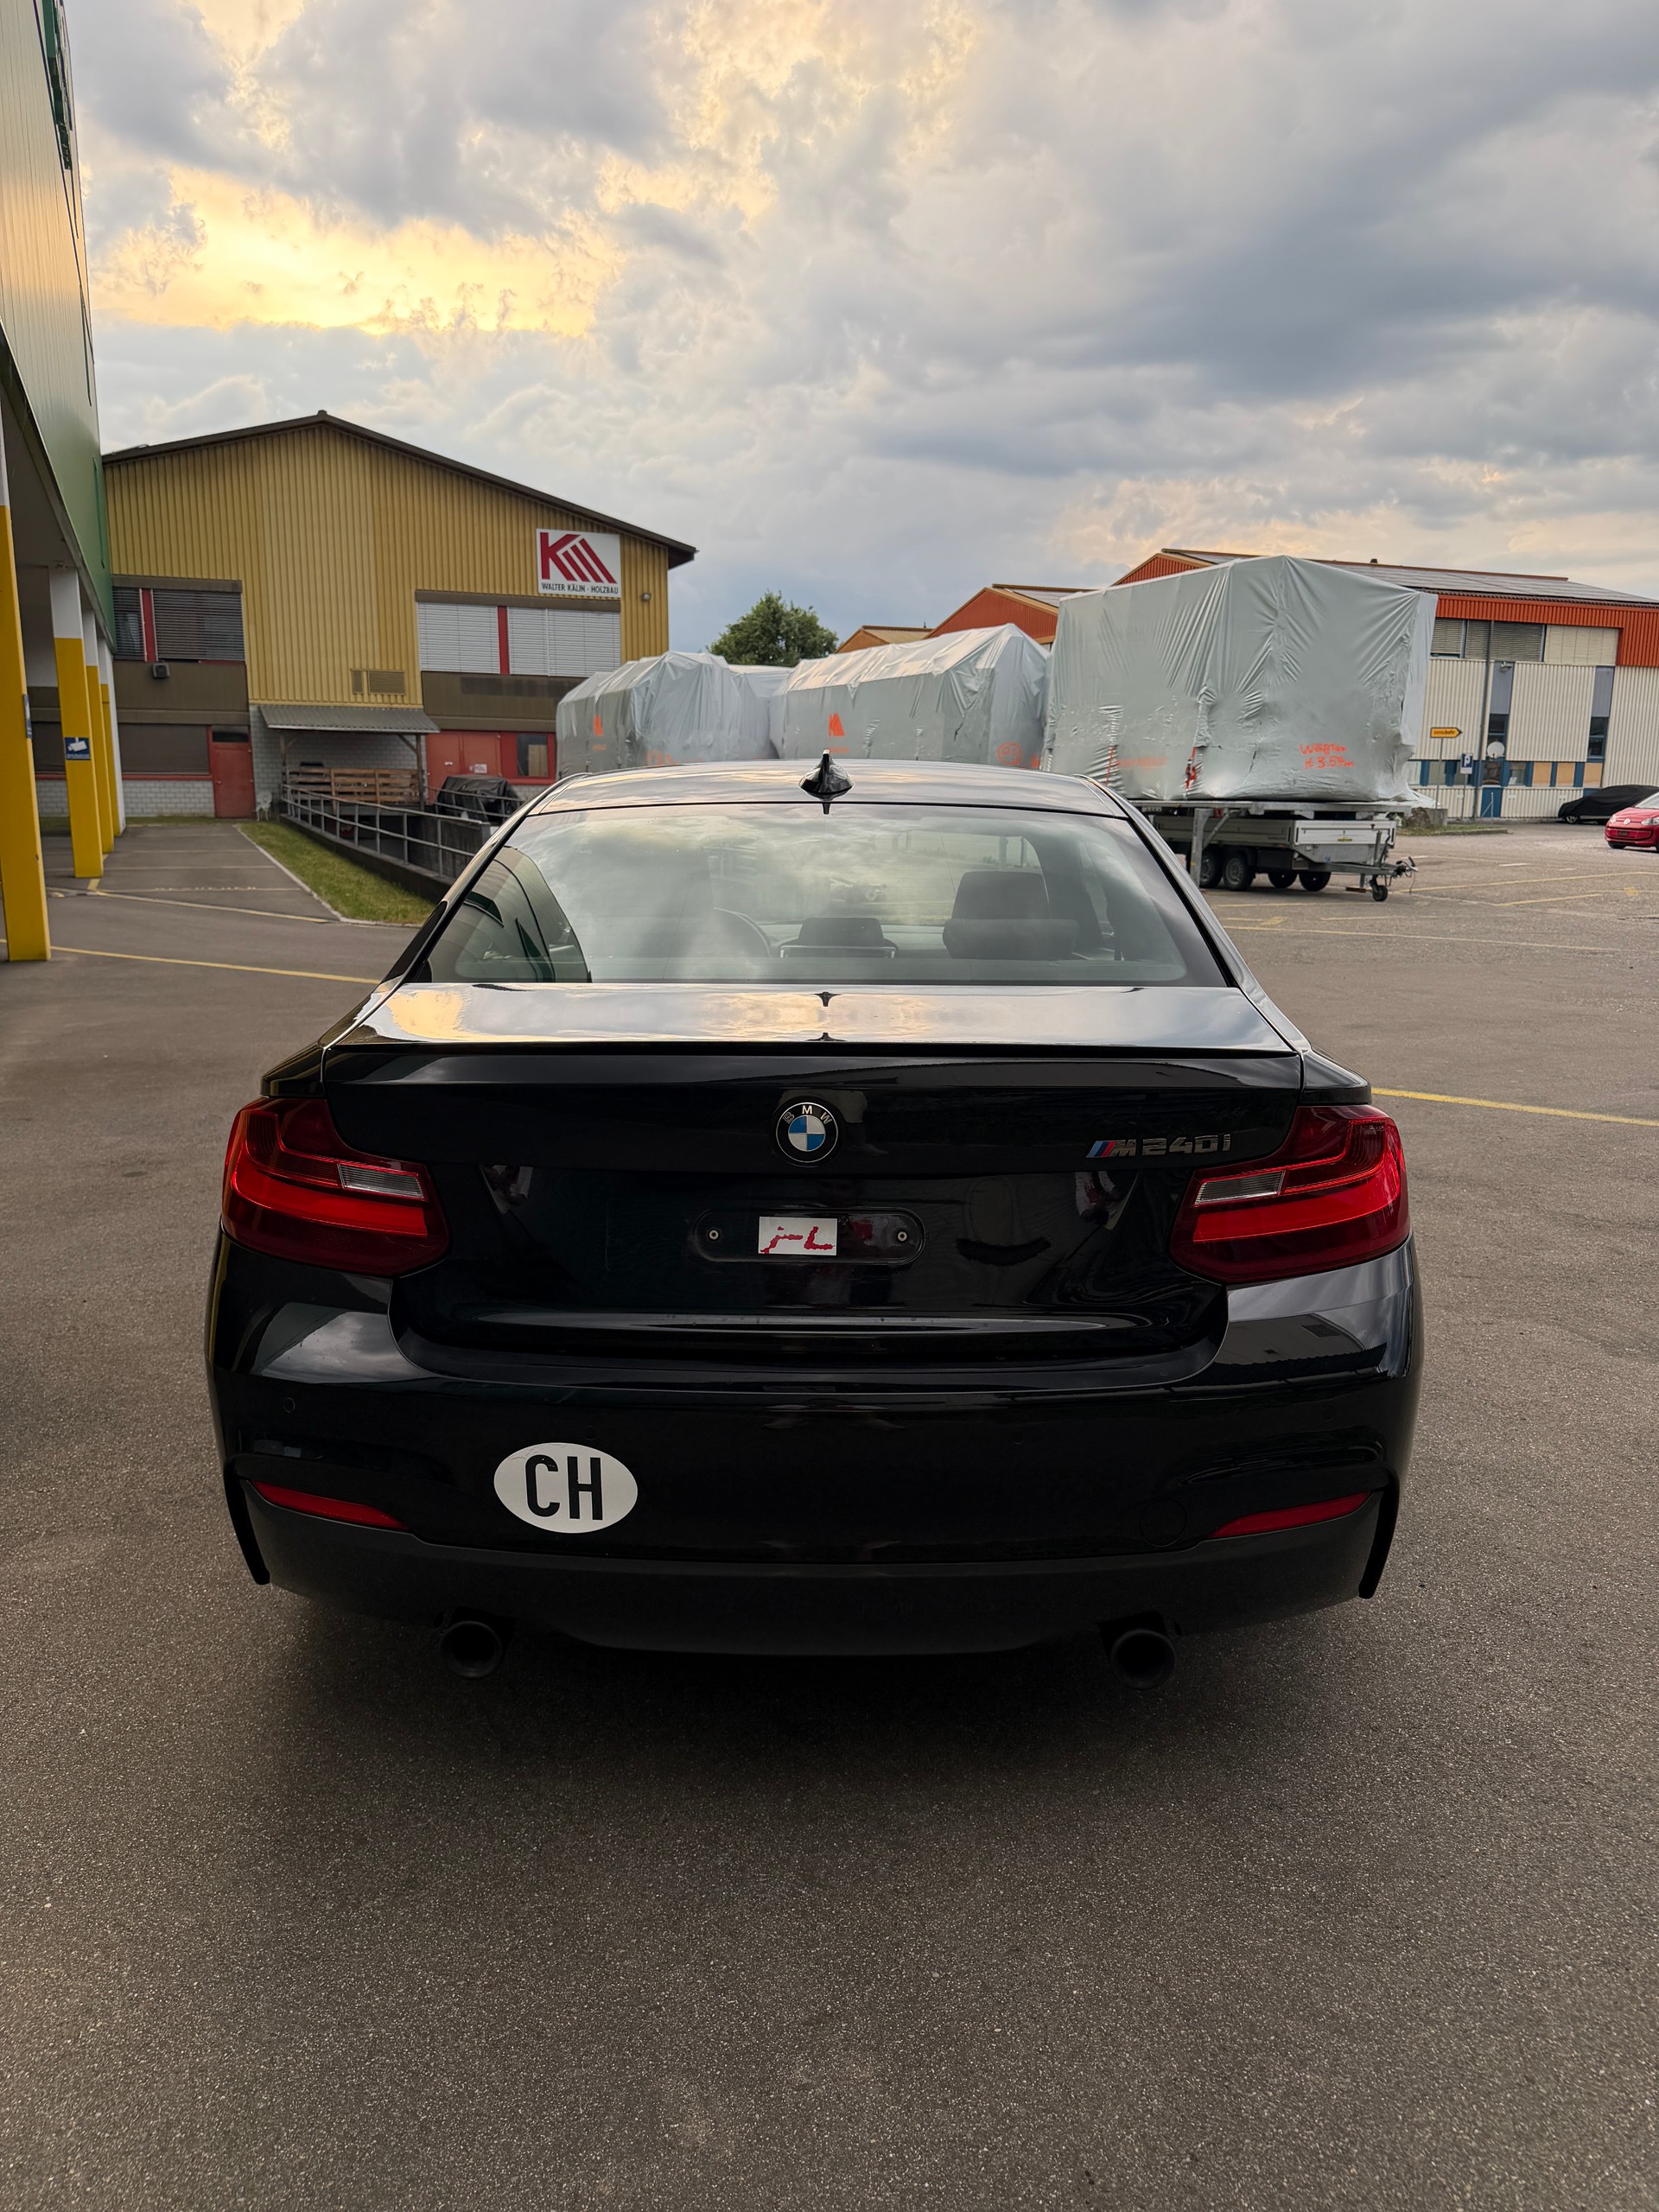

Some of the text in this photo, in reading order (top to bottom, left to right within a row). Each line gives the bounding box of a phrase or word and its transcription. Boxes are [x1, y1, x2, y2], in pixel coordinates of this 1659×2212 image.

[542, 582, 566, 592] WALTER
[567, 583, 586, 593] KÄLIN
[590, 586, 619, 594] HOLZBAU
[1464, 754, 1471, 766] P
[782, 1105, 833, 1125] BMW
[1108, 1134, 1230, 1158] M240i
[524, 1454, 604, 1521] CH
